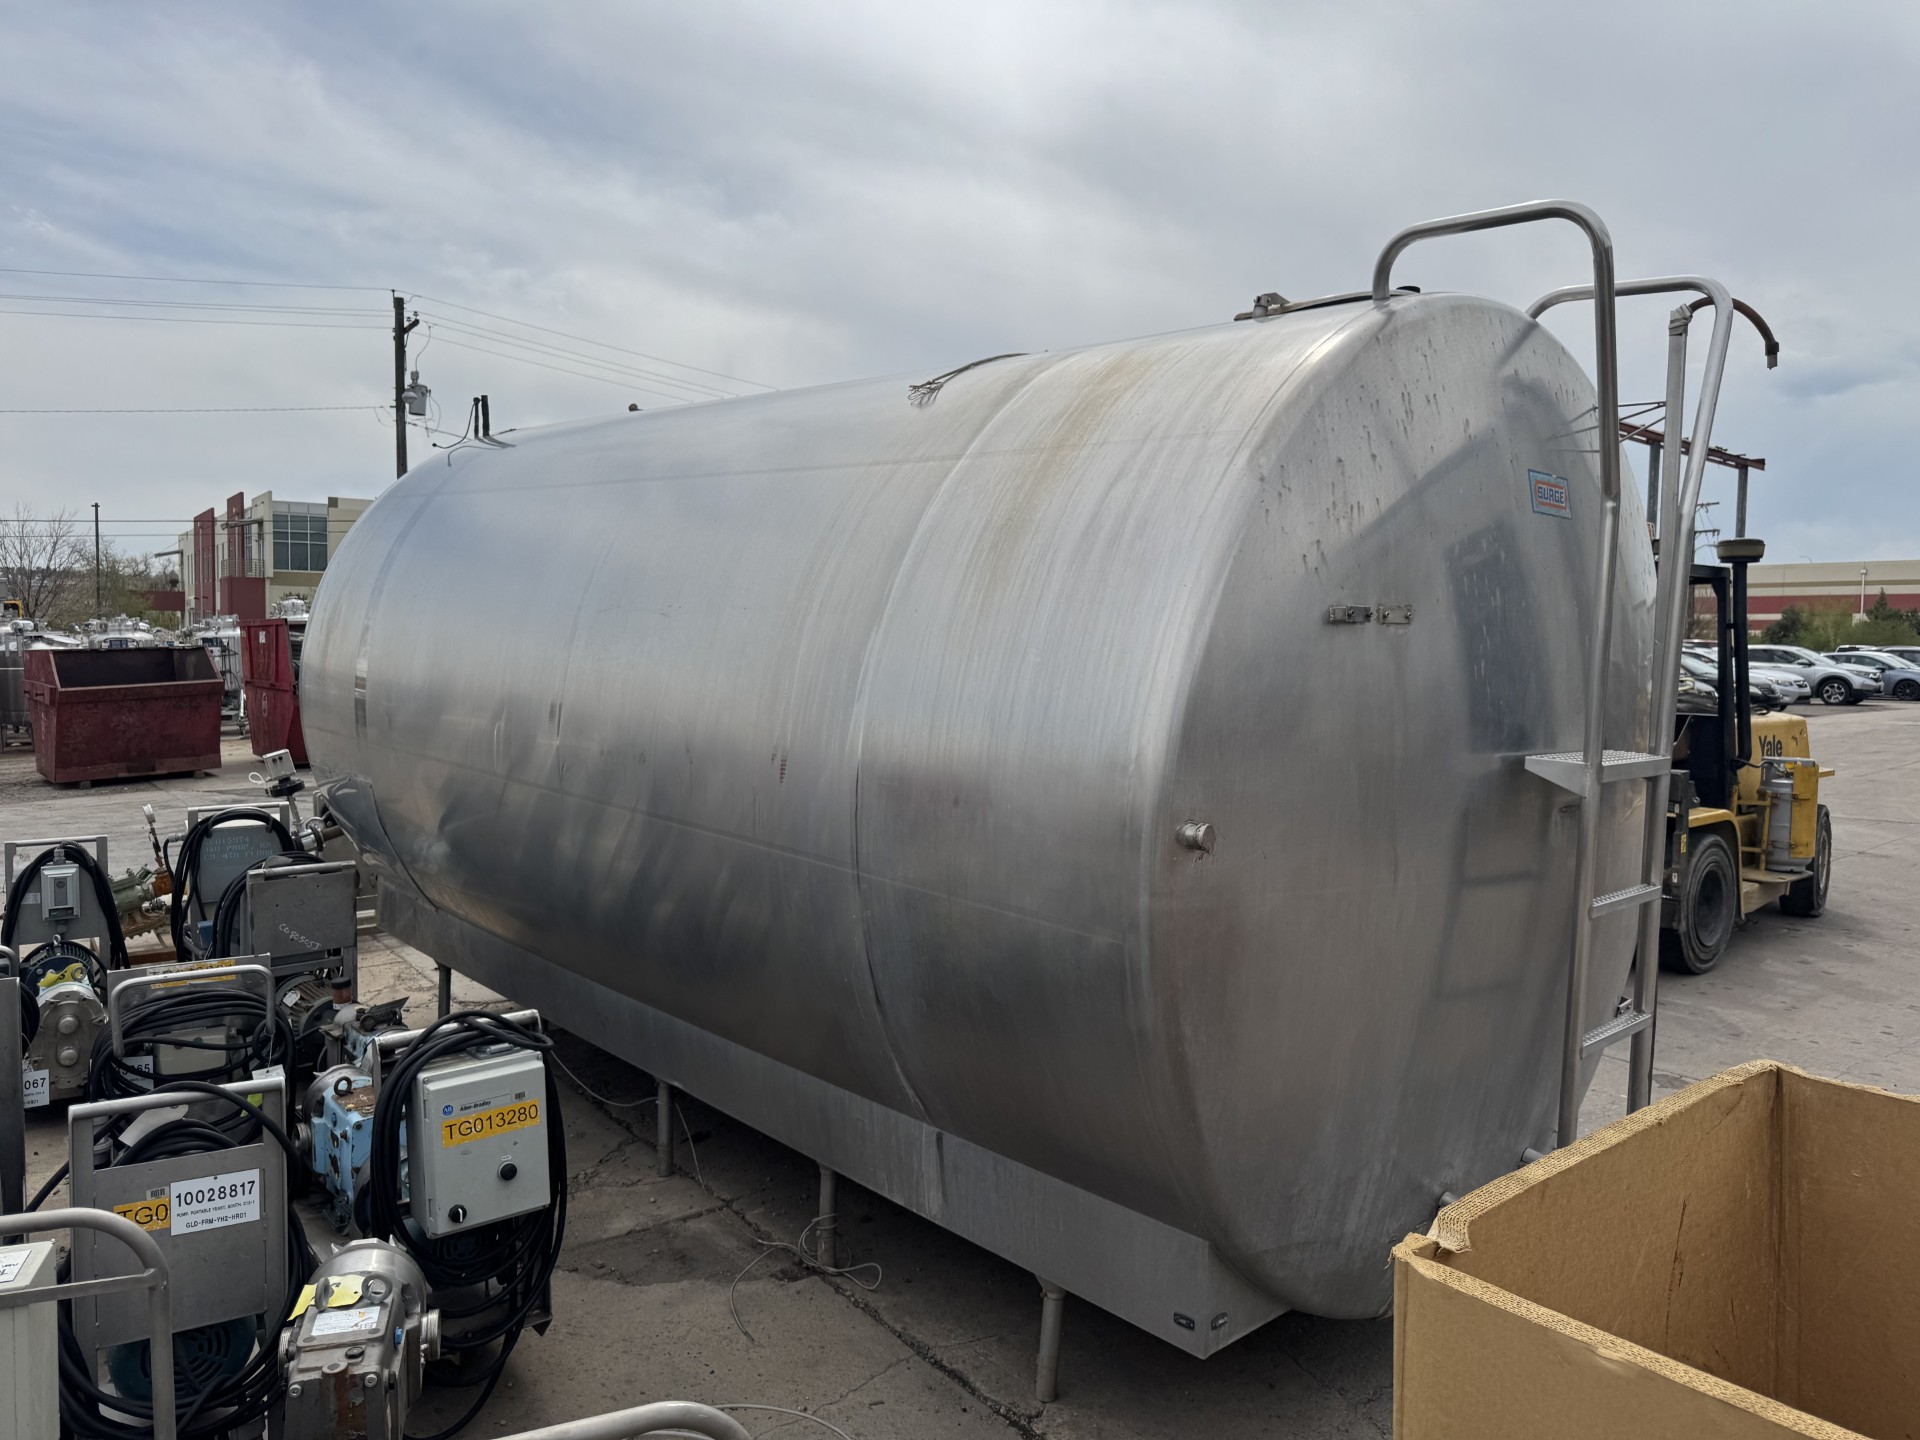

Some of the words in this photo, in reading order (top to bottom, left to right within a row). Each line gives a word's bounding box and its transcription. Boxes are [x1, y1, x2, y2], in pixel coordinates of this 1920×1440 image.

[1537, 486, 1564, 504] SURGE
[1758, 734, 1783, 757] Yale
[459, 1100, 492, 1113] Allen-Bradley
[444, 1103, 539, 1140] TG013280
[175, 1180, 256, 1207] 10028817
[190, 1208, 212, 1216] PORTABLE
